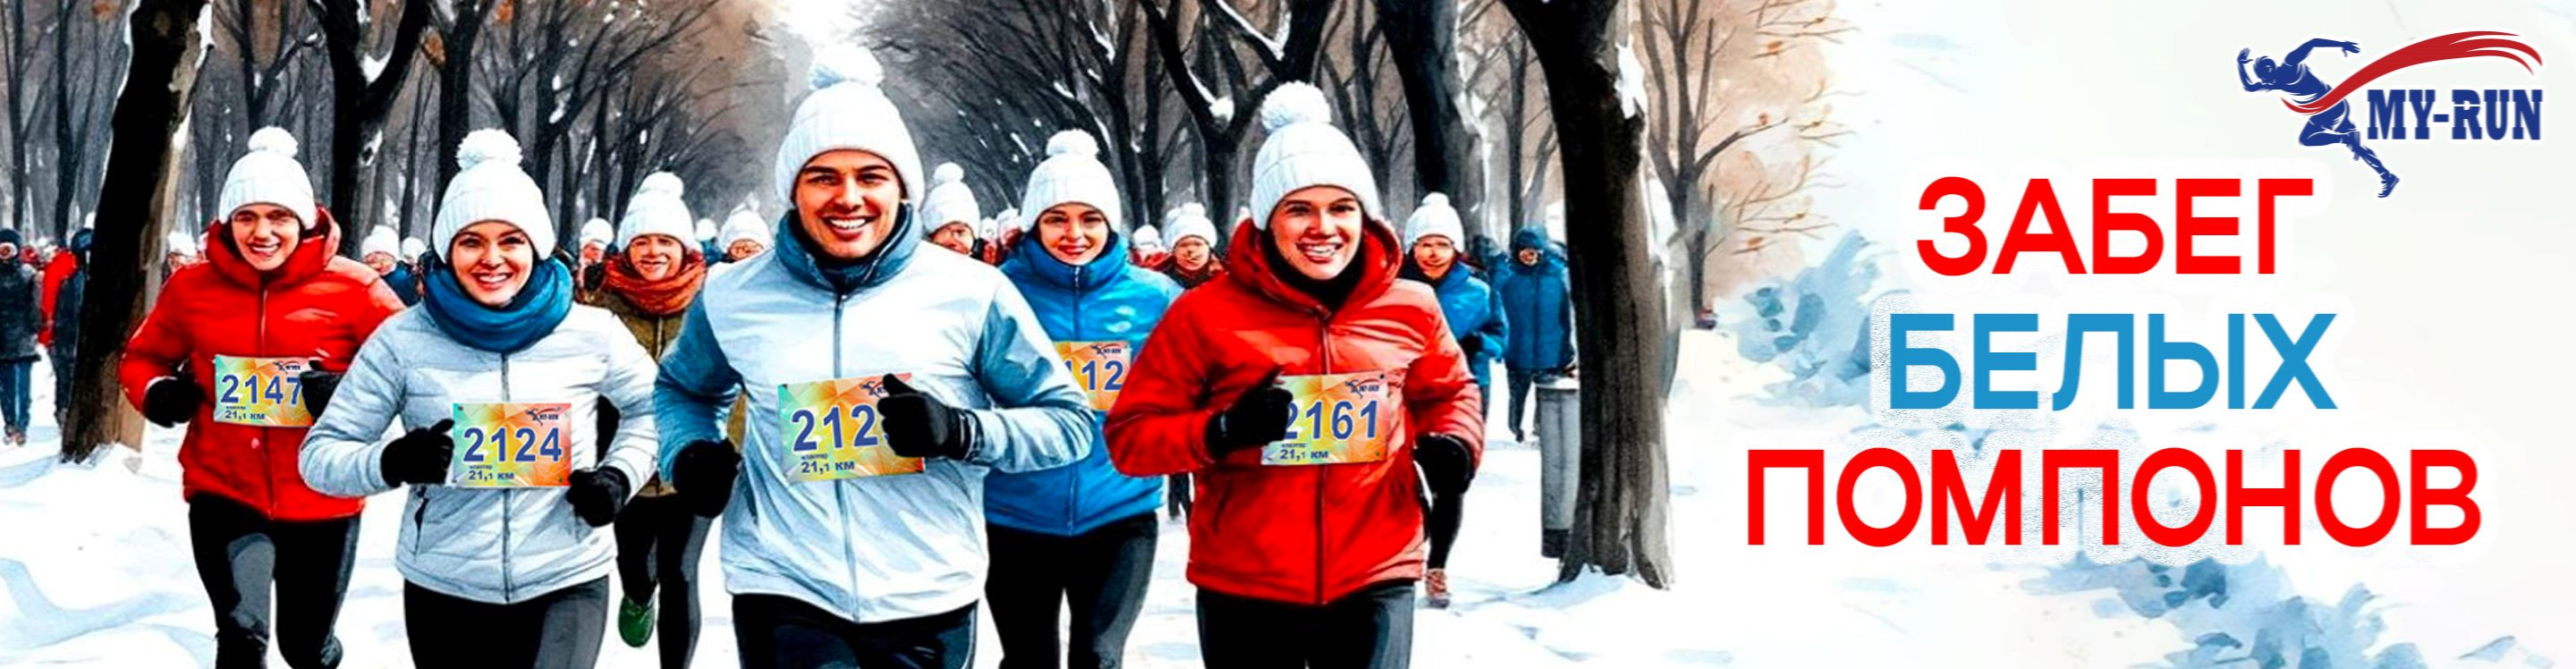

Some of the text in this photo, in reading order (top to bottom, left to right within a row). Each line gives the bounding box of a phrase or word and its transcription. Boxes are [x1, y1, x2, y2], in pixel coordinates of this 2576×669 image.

[220, 374, 302, 405] 2147
[225, 410, 247, 420] 21,1
[1284, 400, 1377, 440] 2161
[791, 403, 889, 453] 212
[462, 427, 563, 462] 2124
[1280, 449, 1306, 461] 21,1
[468, 470, 493, 481] 21,1
[801, 461, 830, 474] 21,1
